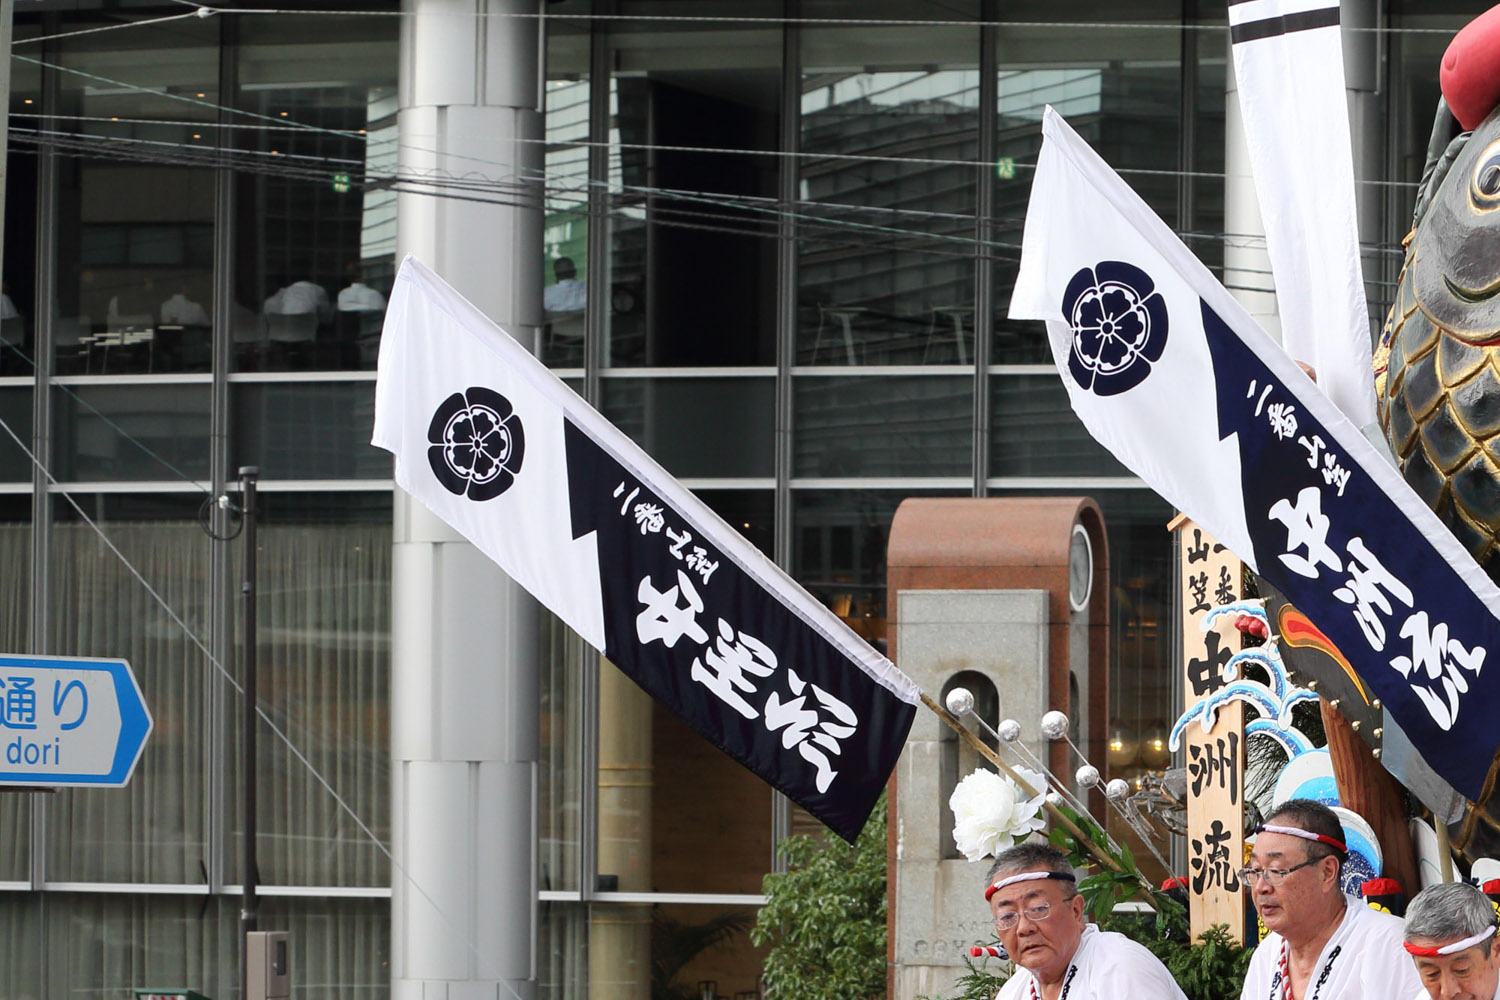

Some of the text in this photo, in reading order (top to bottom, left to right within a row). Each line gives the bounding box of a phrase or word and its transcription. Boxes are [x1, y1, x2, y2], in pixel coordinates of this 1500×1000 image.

[1247, 379, 1351, 496] 二番山笠
[1268, 487, 1487, 731] 中洲流
[7, 736, 60, 765] dori
